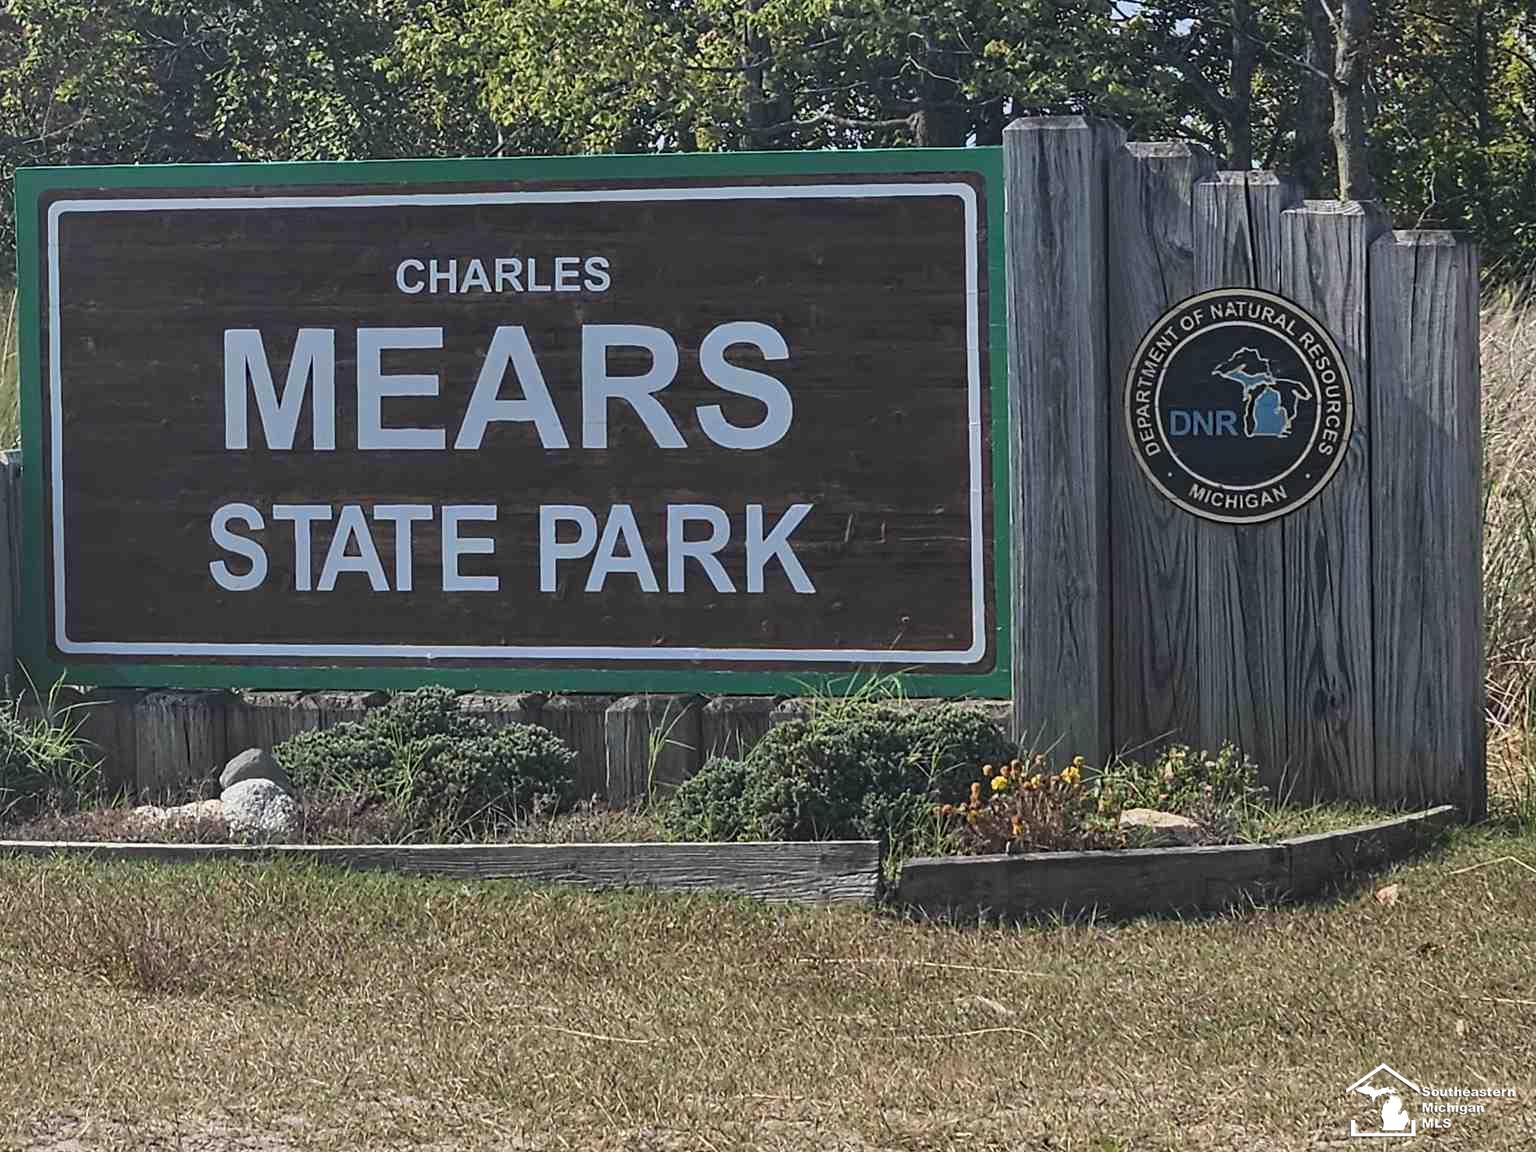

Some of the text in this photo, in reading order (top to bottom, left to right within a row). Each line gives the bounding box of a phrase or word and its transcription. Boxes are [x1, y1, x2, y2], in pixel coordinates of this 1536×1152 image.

[396, 256, 612, 294] CHARLES
[224, 321, 794, 450] MEARS
[1135, 301, 1342, 457] DEPARTMENT OF NATURAL RESOURCES
[1169, 409, 1239, 437] DNR
[1188, 482, 1288, 509] MICHIGAN
[209, 503, 816, 593] STATE PARK
